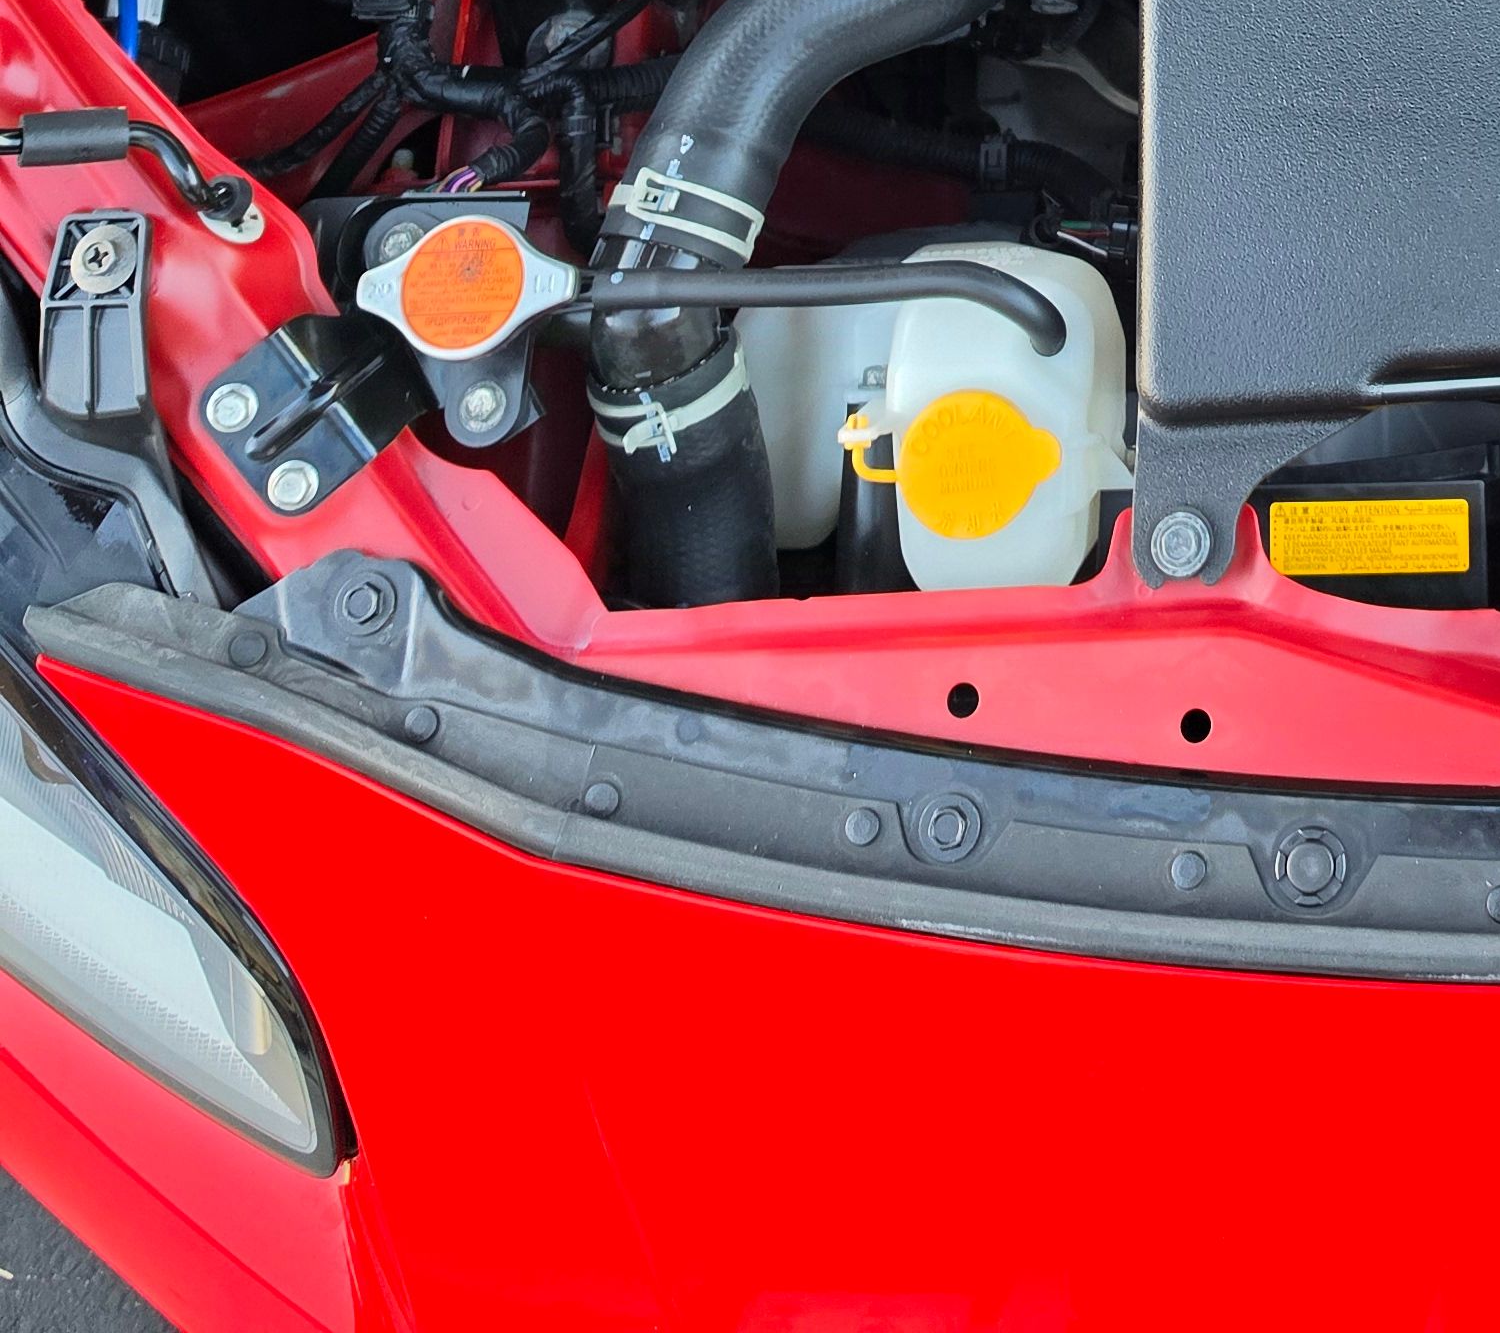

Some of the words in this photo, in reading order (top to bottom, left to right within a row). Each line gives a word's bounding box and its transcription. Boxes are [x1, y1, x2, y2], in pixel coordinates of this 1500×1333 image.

[910, 402, 1018, 455] COOLANT
[1313, 506, 1348, 515] CAUTION
[1354, 505, 1400, 515] ATTENTION
